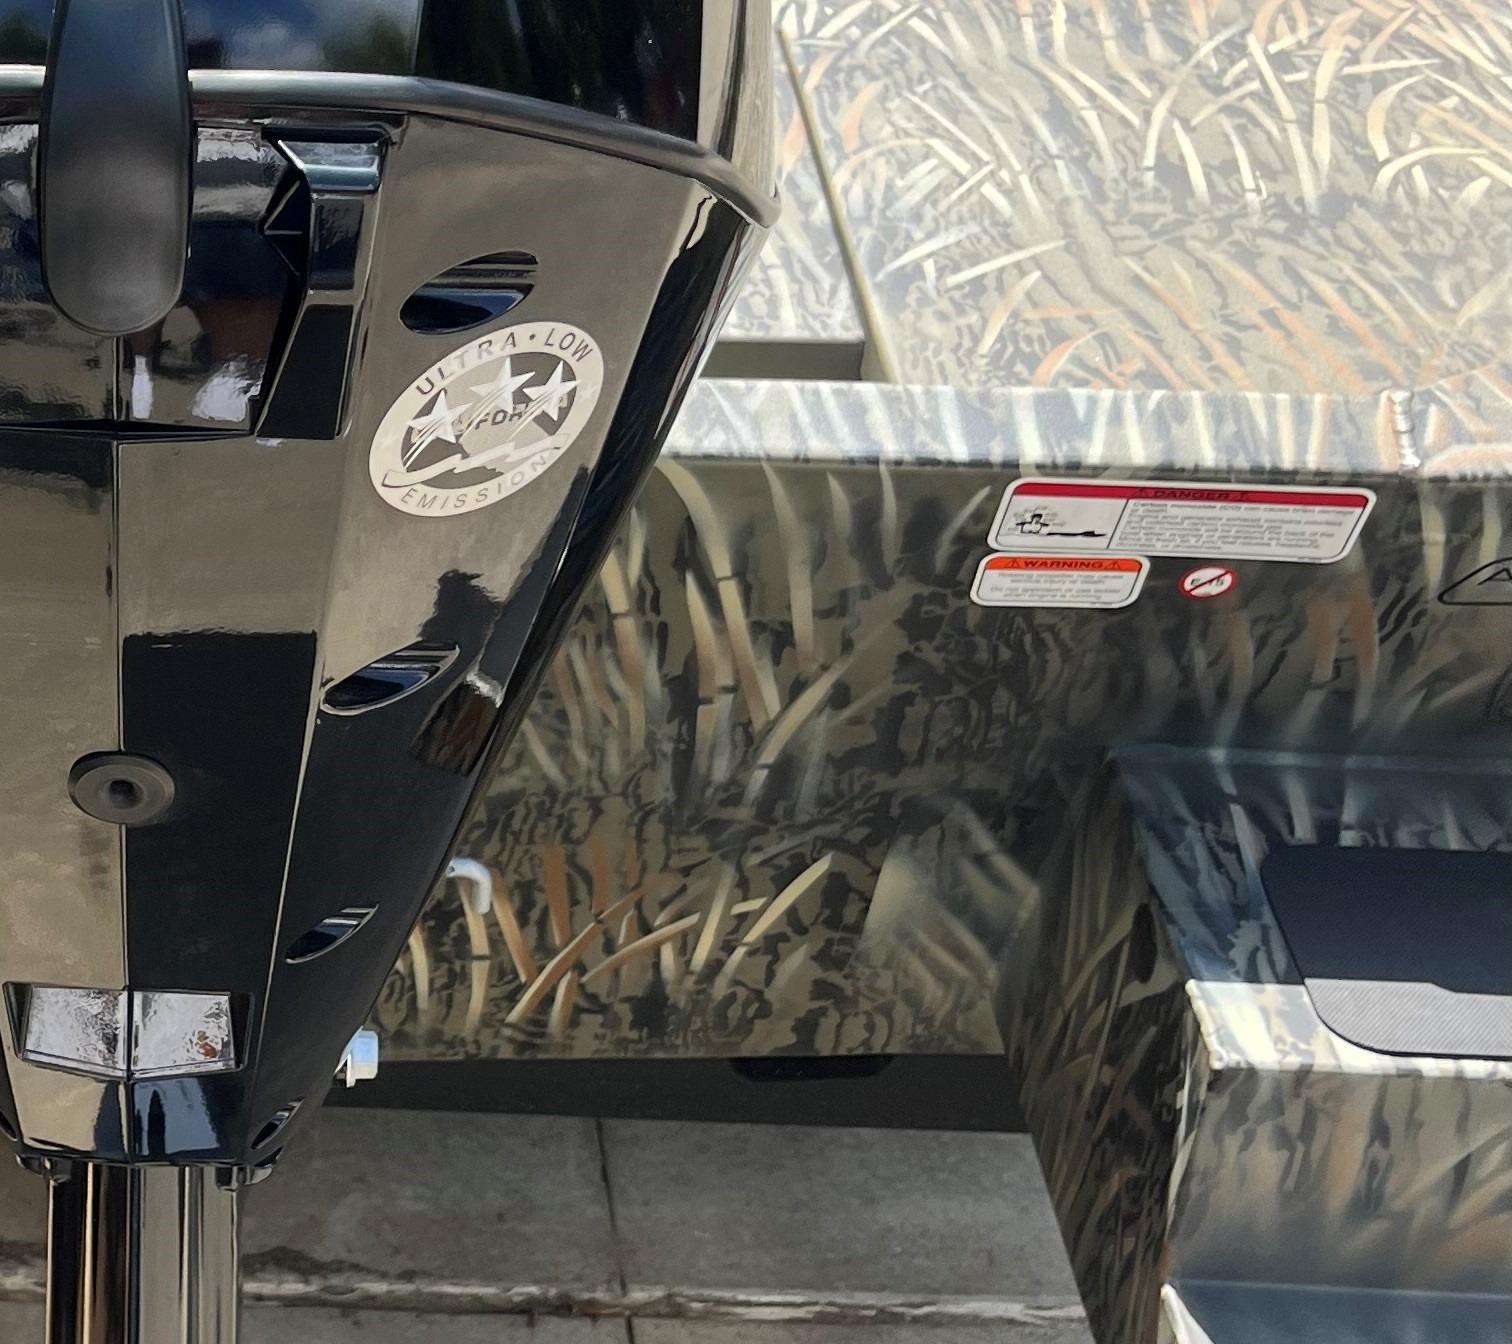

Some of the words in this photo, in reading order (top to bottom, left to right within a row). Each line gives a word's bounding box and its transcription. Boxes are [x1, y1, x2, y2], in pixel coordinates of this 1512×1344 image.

[415, 331, 518, 396] ULTRA
[543, 327, 594, 363] LOW
[399, 455, 548, 511] EMISSION
[1152, 489, 1230, 500] DANGER
[1024, 559, 1104, 570] WARNING
